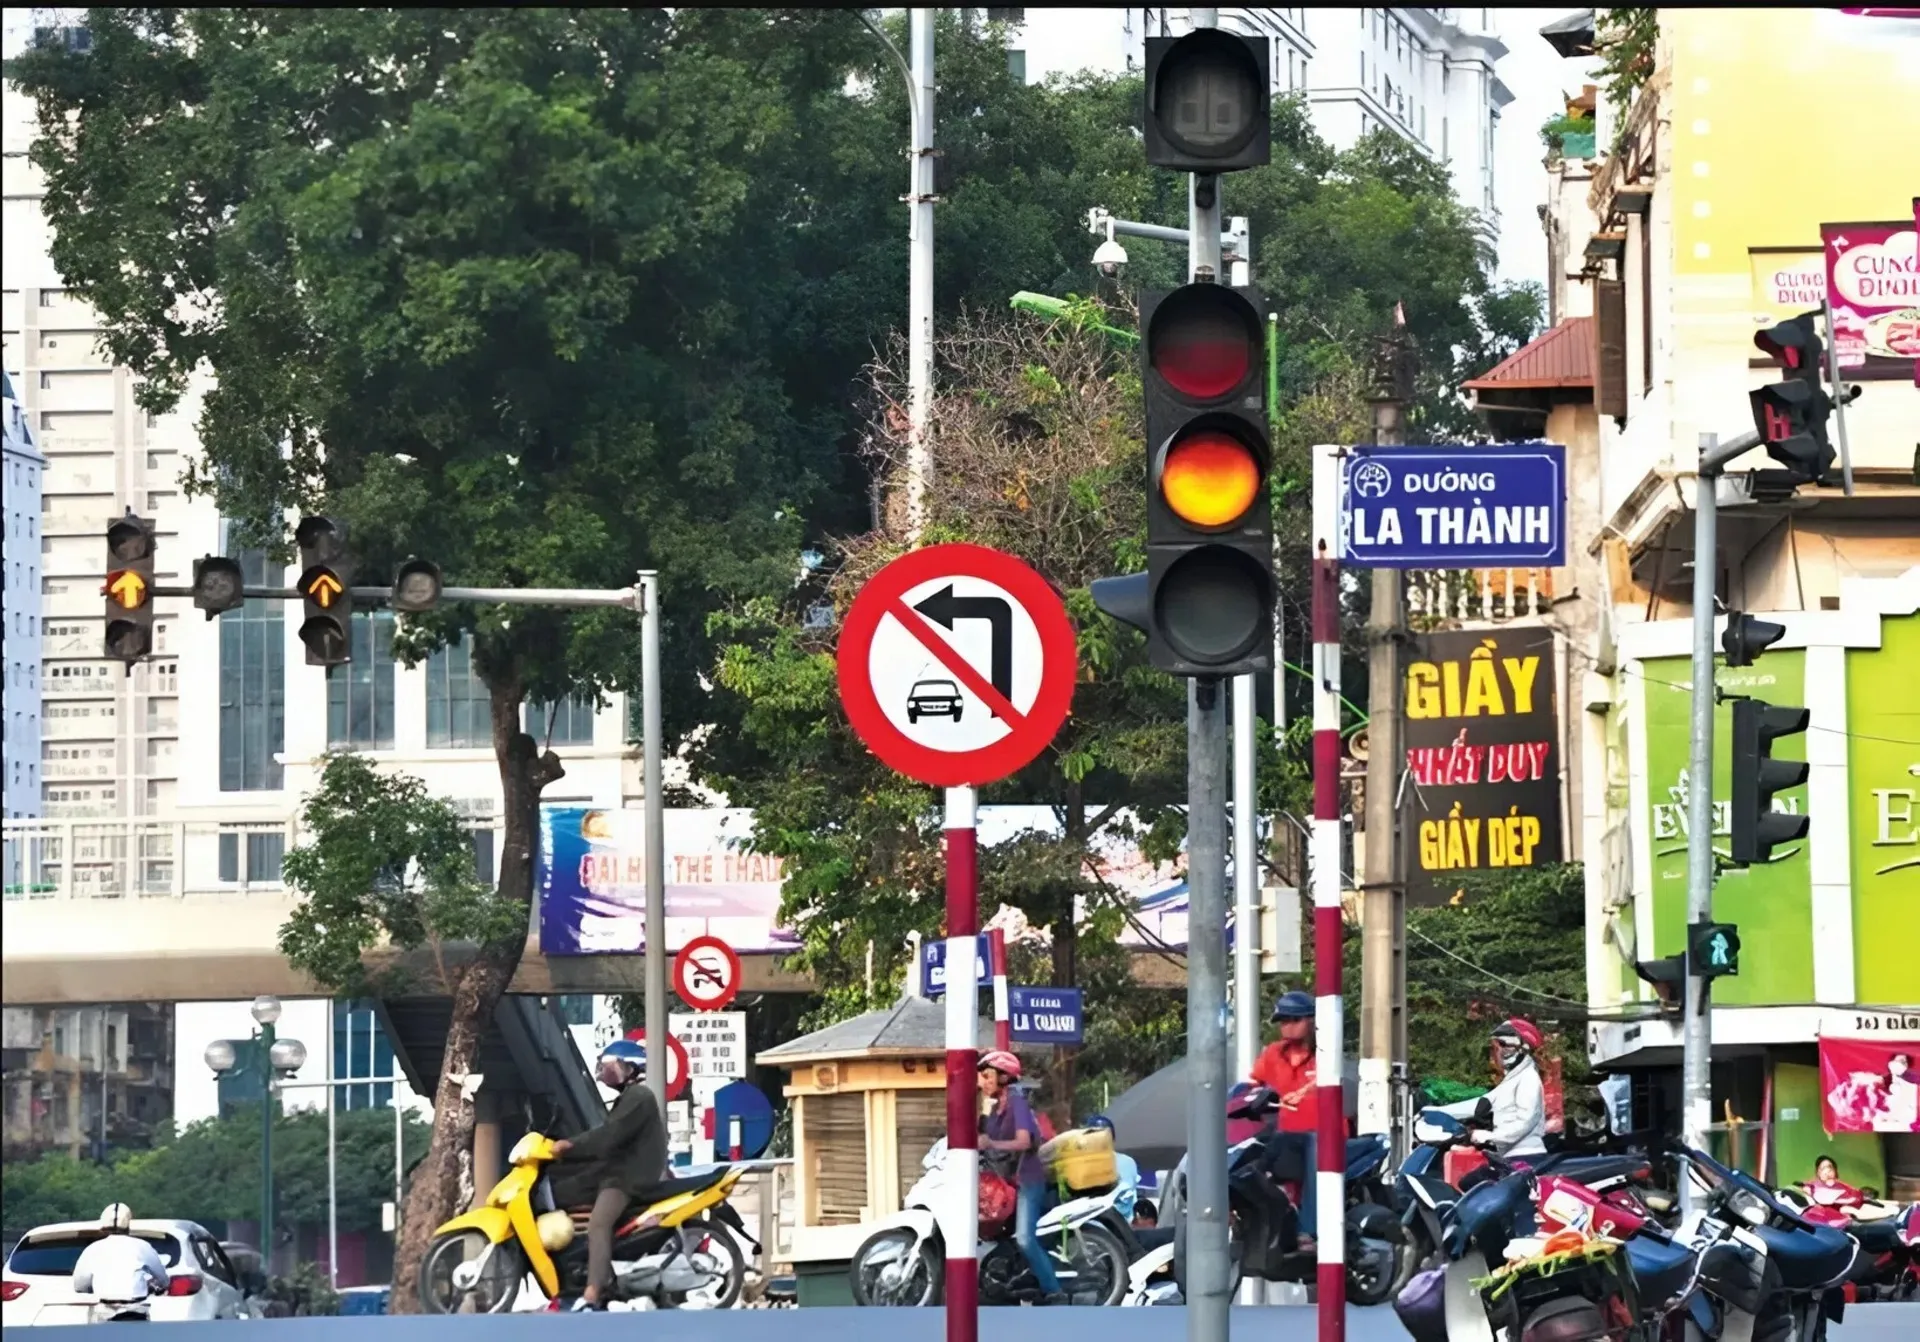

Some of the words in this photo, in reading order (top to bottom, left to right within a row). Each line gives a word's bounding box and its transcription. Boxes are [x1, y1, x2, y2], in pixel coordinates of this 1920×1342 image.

[1354, 508, 1403, 545] LA
[1416, 498, 1550, 544] THÀNH
[1488, 742, 1550, 783] DUY
[1488, 805, 1540, 867] DÉP
